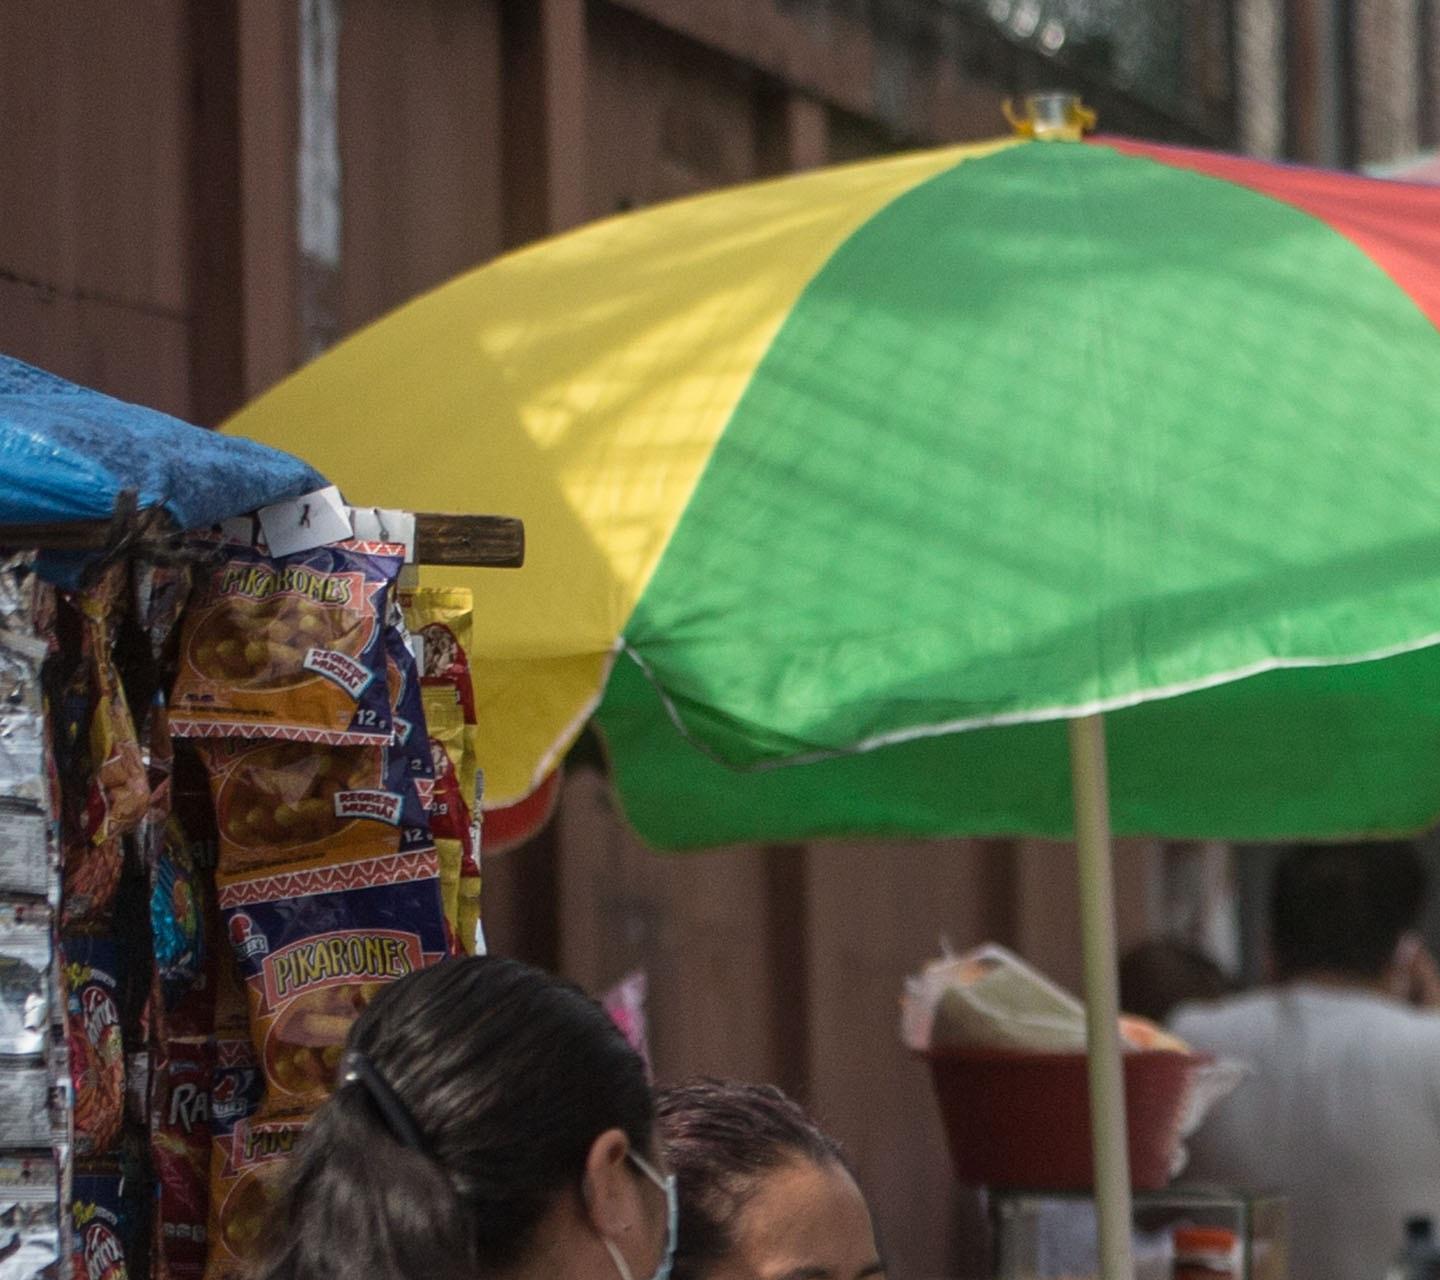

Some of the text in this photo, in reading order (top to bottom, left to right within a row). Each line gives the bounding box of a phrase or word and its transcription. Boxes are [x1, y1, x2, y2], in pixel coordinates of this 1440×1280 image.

[356, 709, 377, 727] 12
[404, 828, 424, 844] 12
[273, 935, 407, 996] PIKARONES
